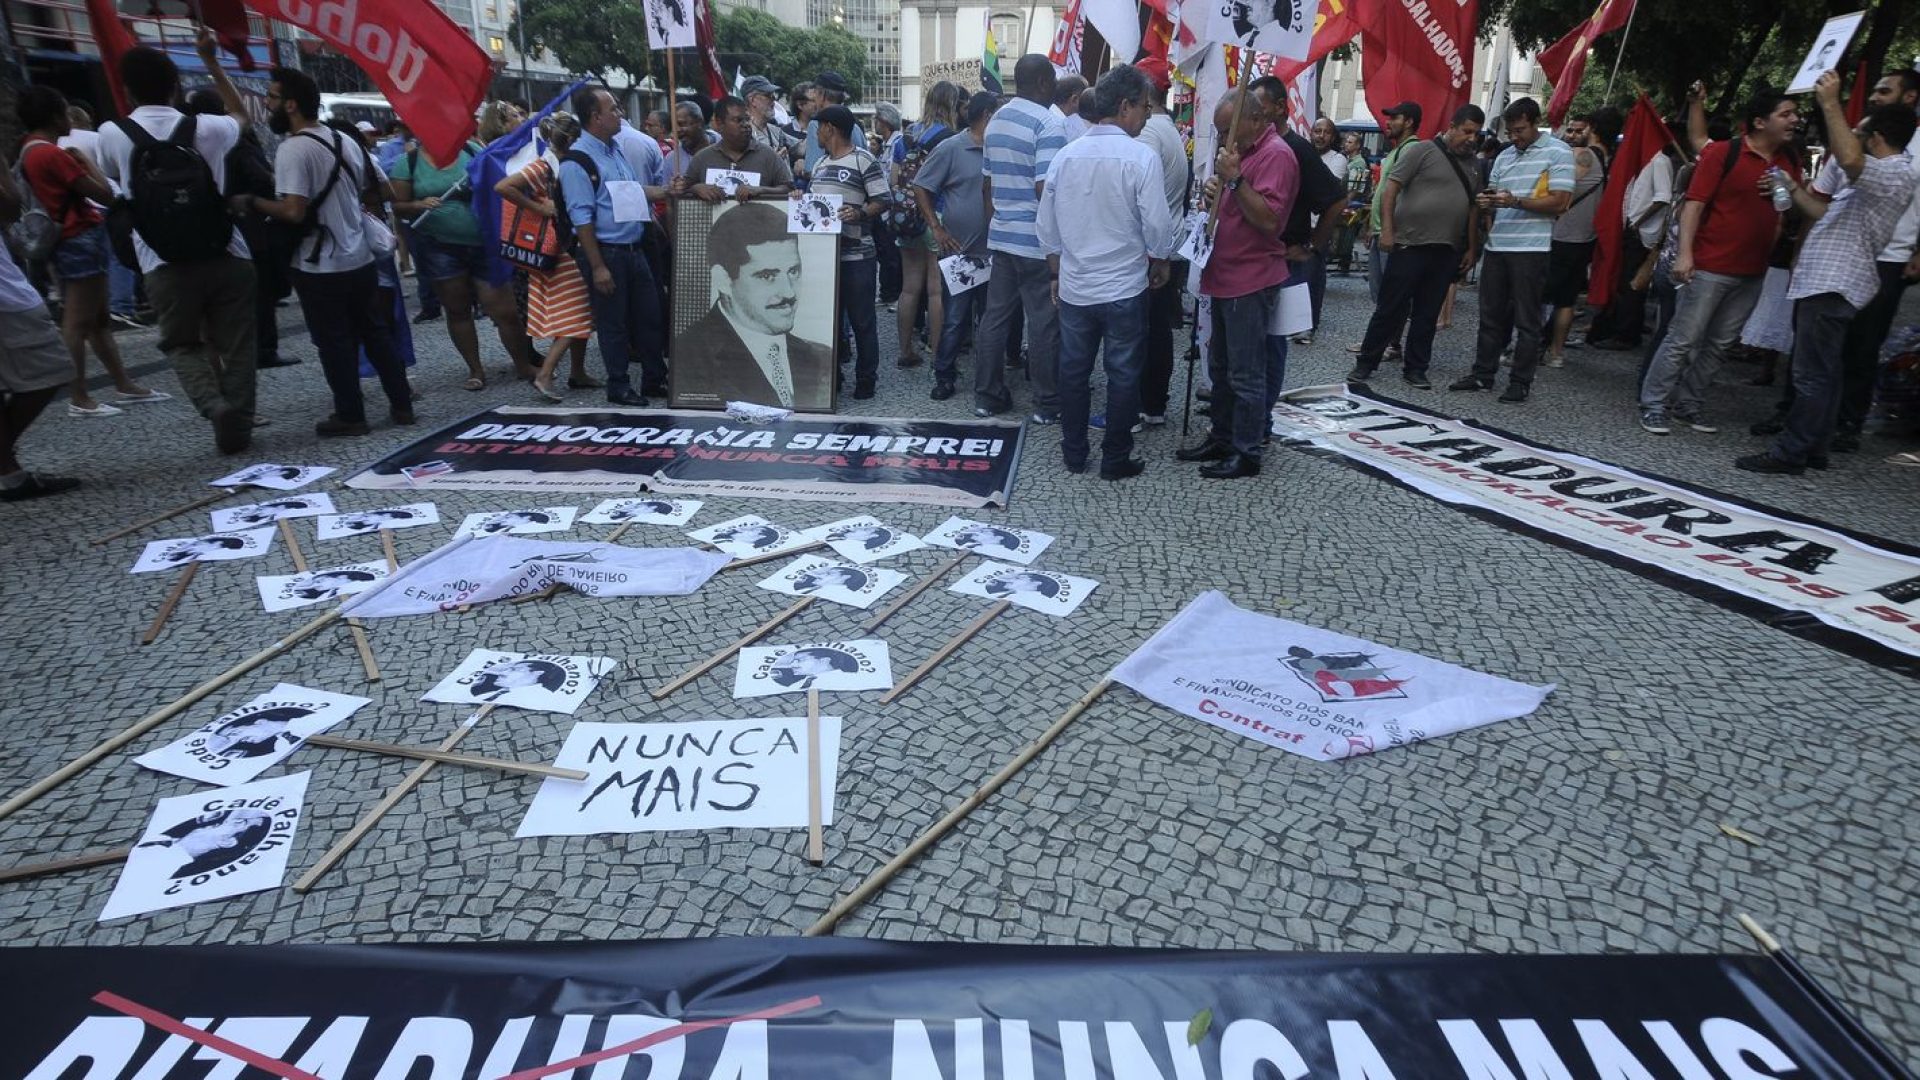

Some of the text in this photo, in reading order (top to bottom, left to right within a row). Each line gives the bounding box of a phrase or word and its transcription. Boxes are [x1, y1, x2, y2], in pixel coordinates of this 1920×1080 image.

[925, 60, 980, 77] QUEREMOS
[500, 243, 544, 267] TOMMY
[434, 443, 992, 472] DITADURA NUNCA MAIS
[786, 433, 1004, 458] SEMPRE!
[1697, 554, 1851, 599] DOS
[1173, 676, 1186, 686] E
[1297, 713, 1322, 727] DO
[1324, 723, 1355, 738] RIO
[1198, 699, 1306, 744] Contraf
[1295, 701, 1330, 718] DOS
[587, 727, 800, 764] NUNCA
[577, 761, 761, 820] MAIS
[164, 795, 298, 896] Cadê Palhano?
